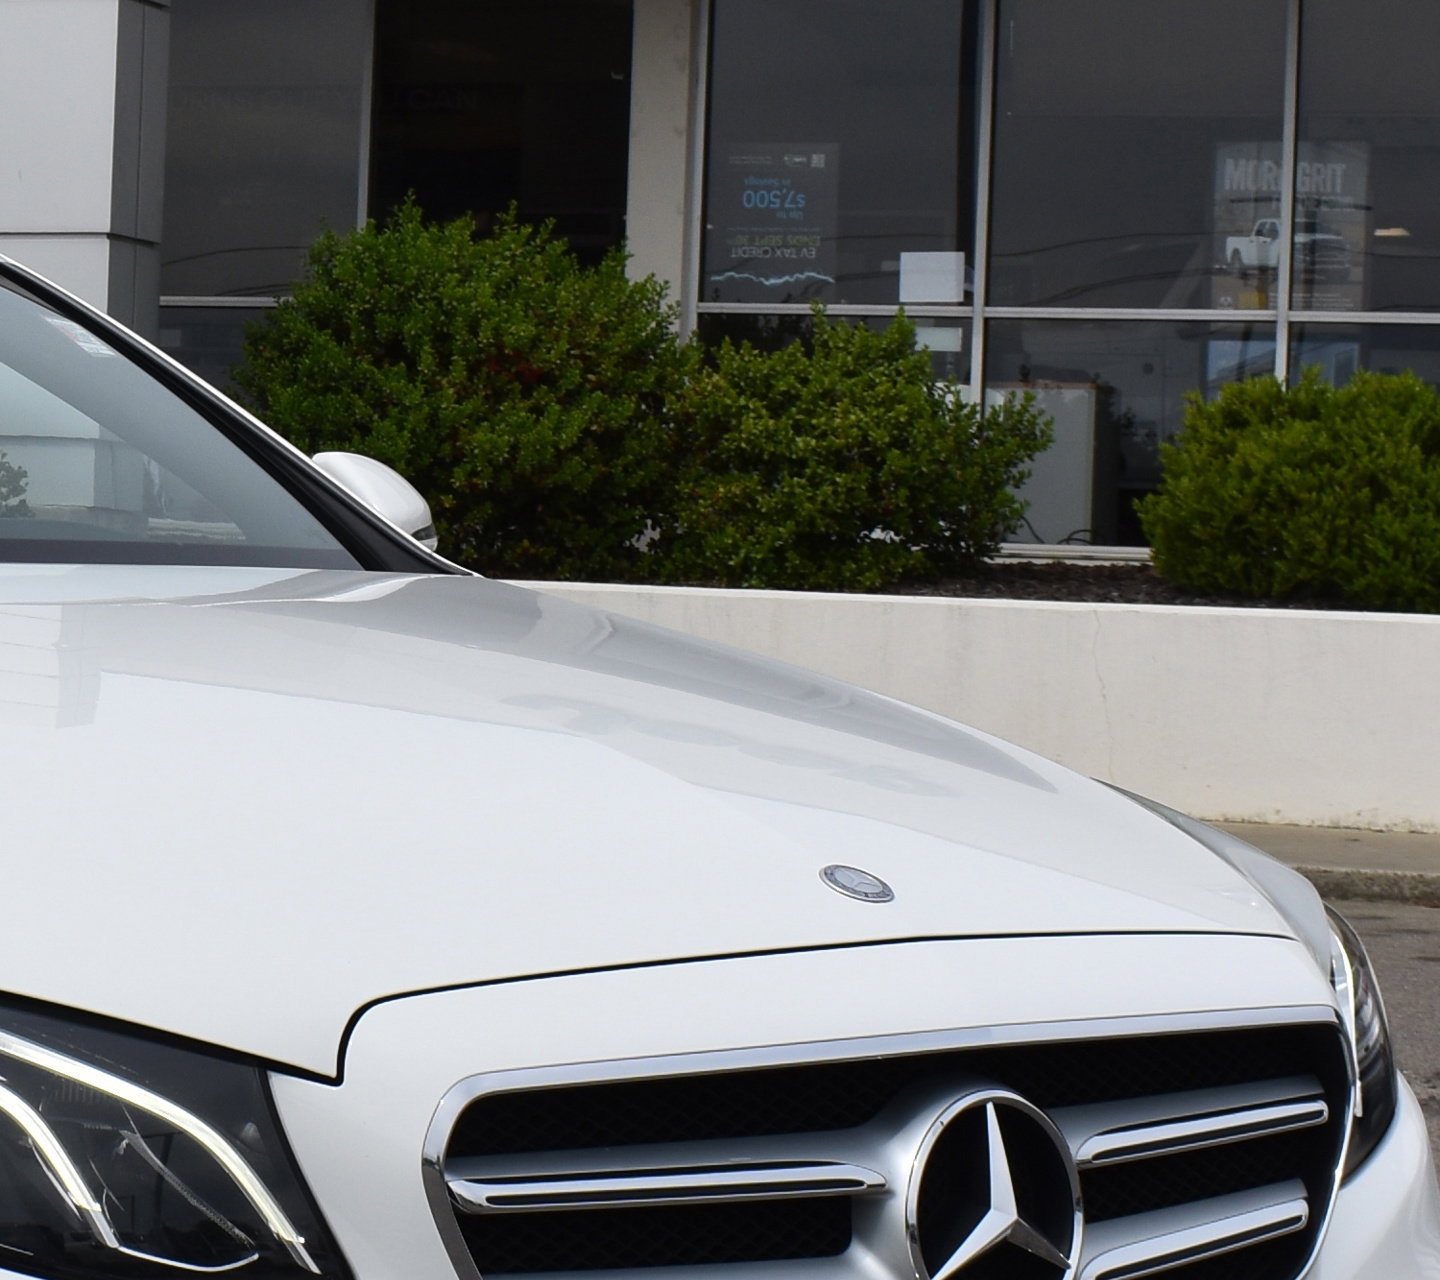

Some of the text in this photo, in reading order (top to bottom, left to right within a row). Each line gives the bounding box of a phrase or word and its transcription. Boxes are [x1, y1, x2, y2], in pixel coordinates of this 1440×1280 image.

[1224, 158, 1347, 193] MOR GRIT
[742, 188, 807, 209] $7,500
[730, 246, 772, 259] CREDIT
[774, 246, 798, 259] TAX
